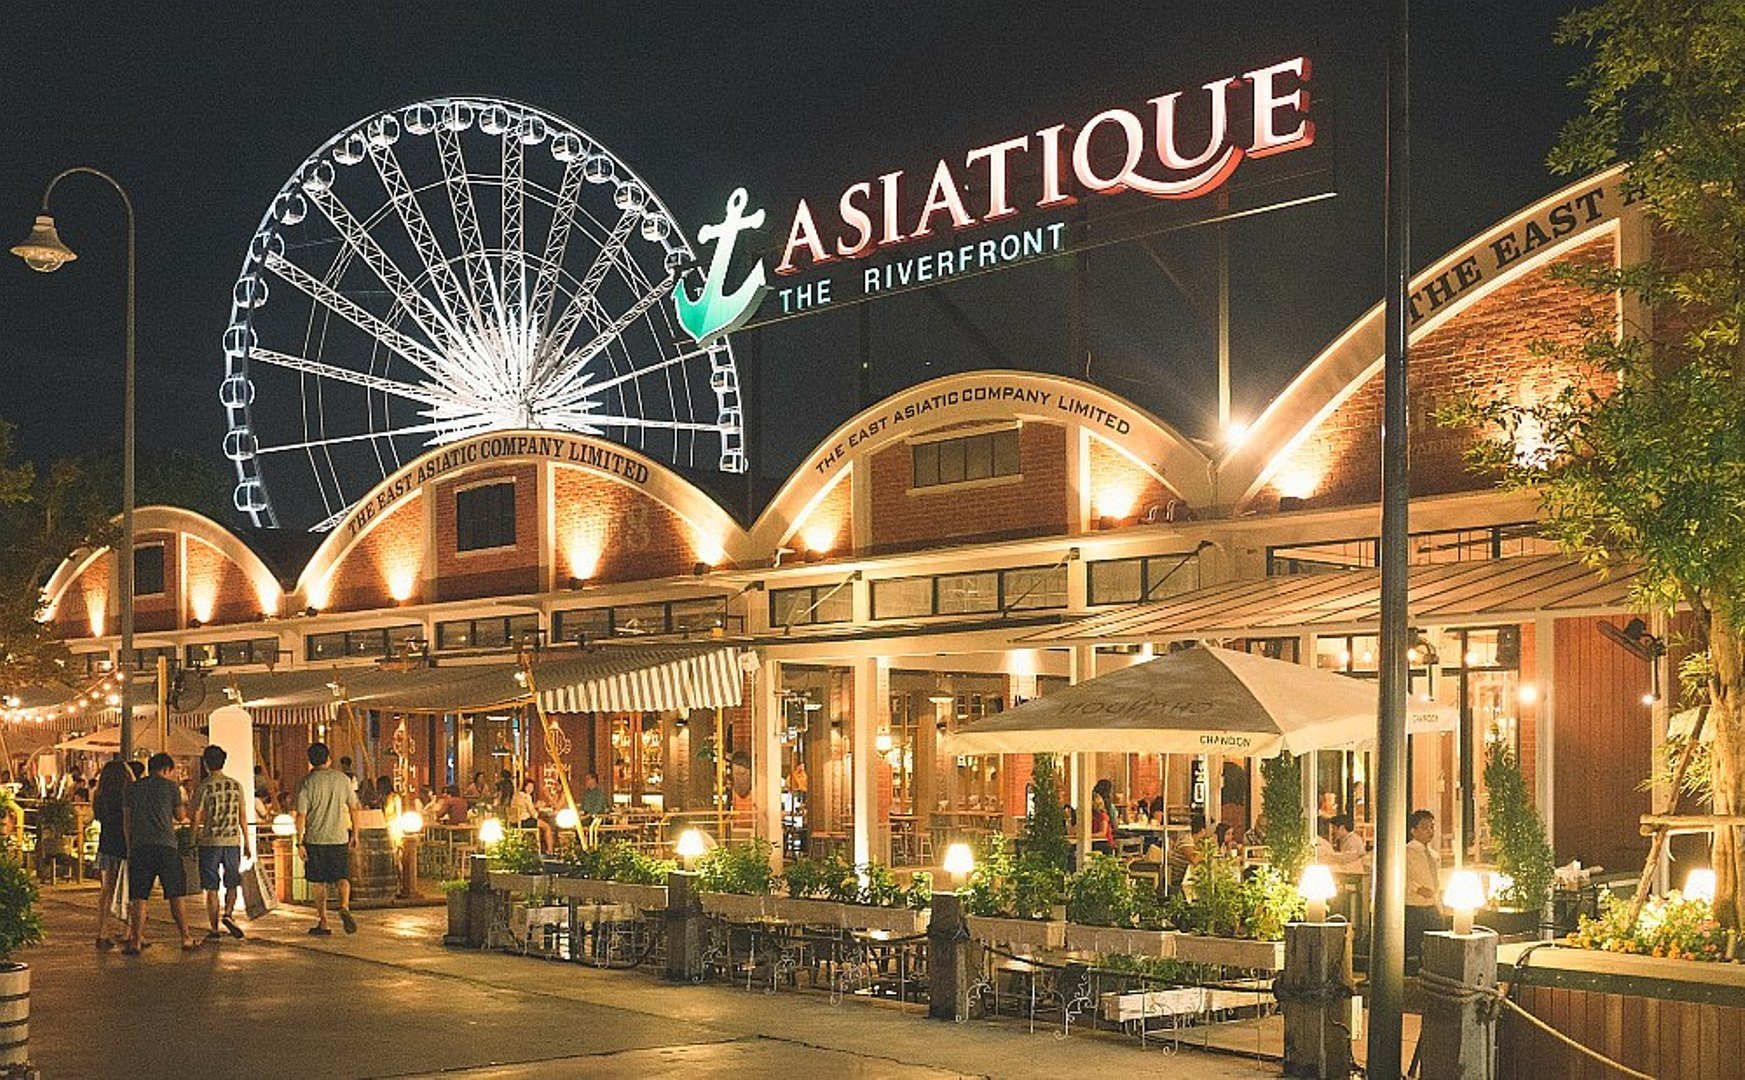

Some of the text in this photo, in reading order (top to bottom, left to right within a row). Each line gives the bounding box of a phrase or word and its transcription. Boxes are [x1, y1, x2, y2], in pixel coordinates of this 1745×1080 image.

[774, 56, 1314, 275] ASIATIQUE
[779, 222, 1066, 314] THE RIVERFRONT
[1407, 188, 1604, 325] THE EAST
[816, 386, 1130, 474] THE EAST ASIATIC COMPANY LIMITED
[348, 436, 649, 536] THE EAST ASIATIC COMPANY LIMITED
[1200, 735, 1251, 747] CHANDON
